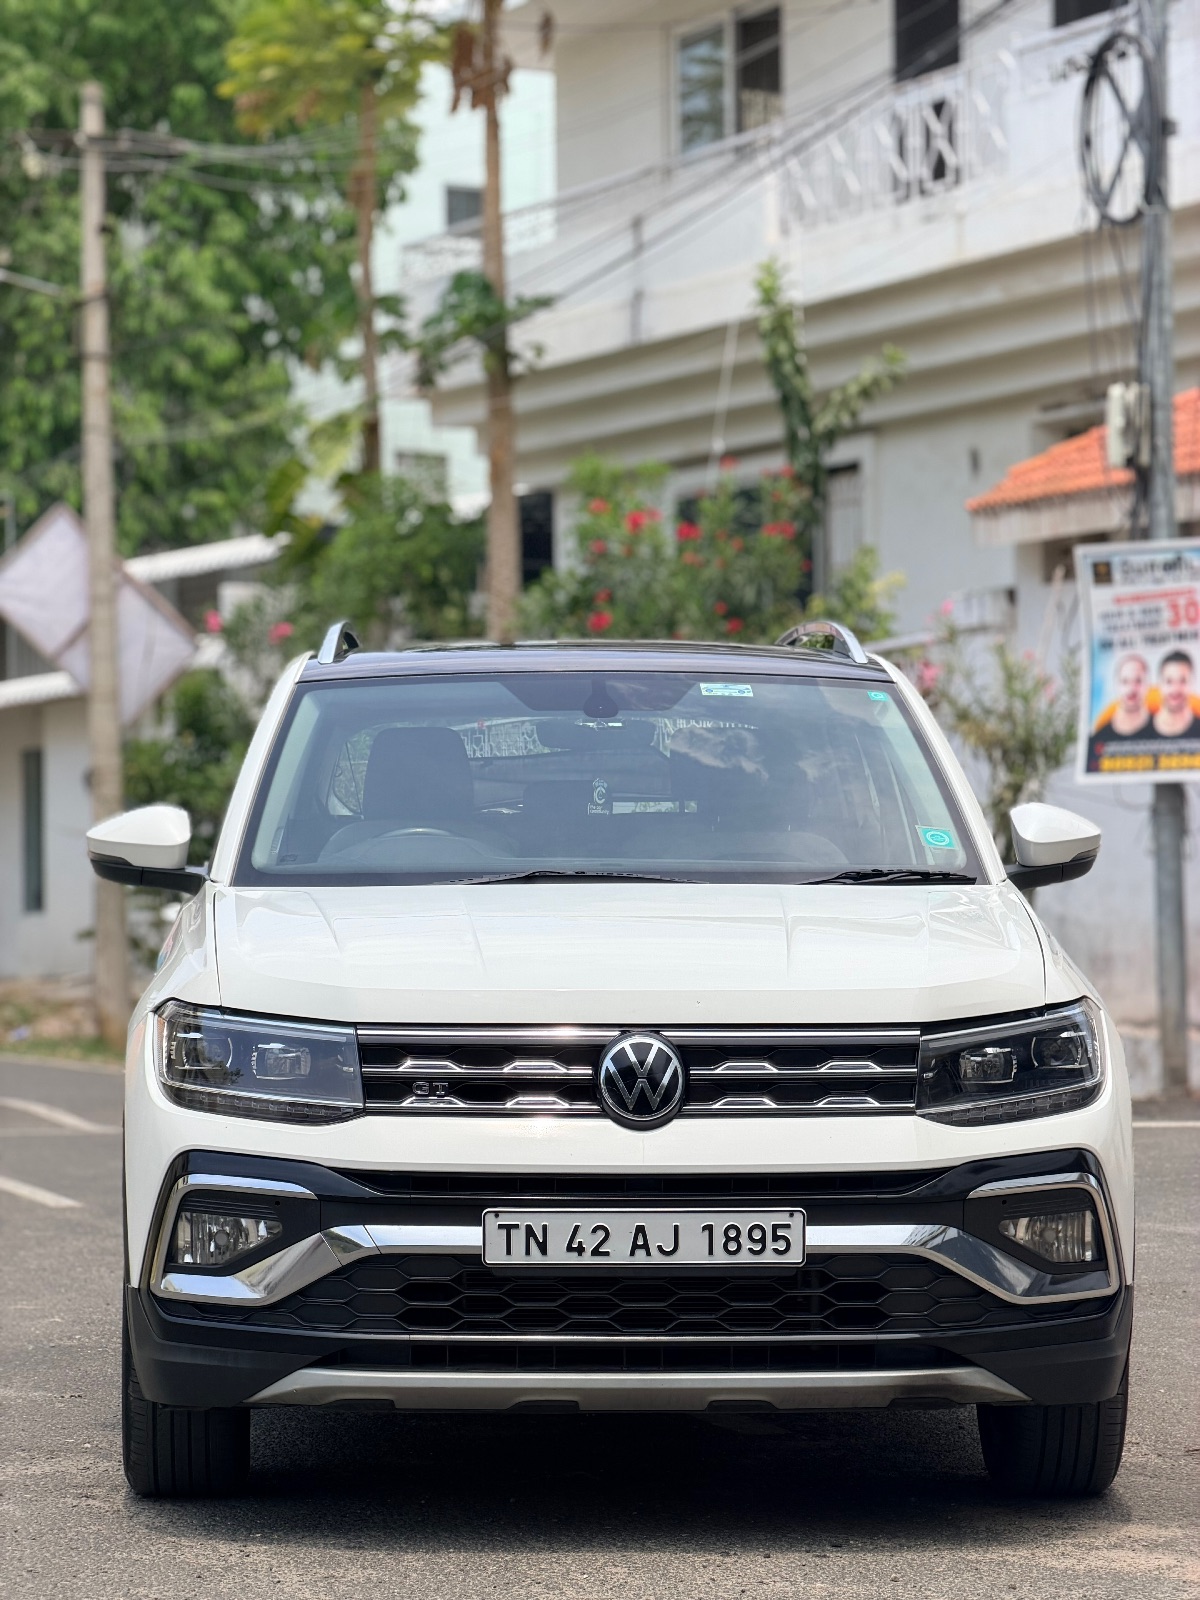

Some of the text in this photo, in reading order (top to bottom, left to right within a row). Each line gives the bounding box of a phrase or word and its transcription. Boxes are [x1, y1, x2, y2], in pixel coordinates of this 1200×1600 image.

[412, 1081, 449, 1096] GT
[497, 1222, 792, 1257] TN 42 AJ 1895
